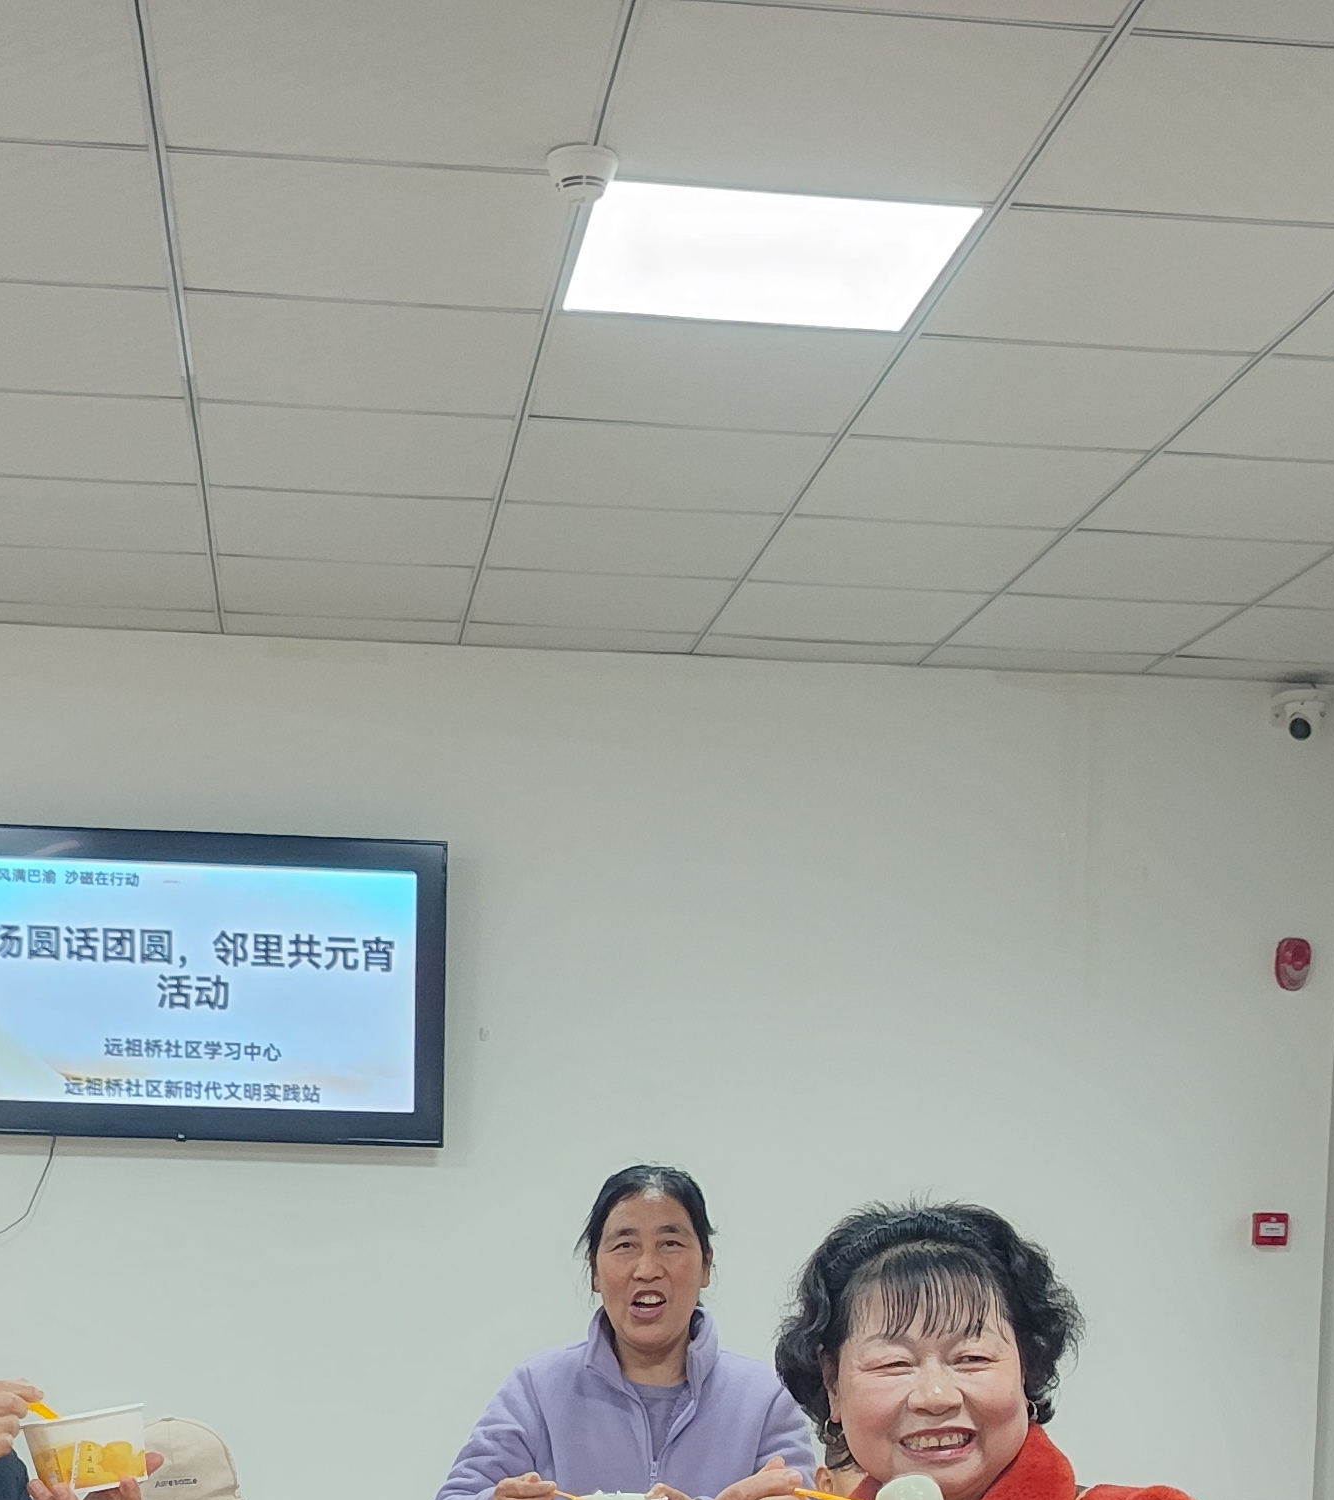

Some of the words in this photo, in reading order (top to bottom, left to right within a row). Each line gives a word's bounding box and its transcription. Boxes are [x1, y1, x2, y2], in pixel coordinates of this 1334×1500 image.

[64, 870, 140, 887] 沙磁在行动
[157, 973, 231, 1011] 活动
[103, 1036, 282, 1063] 远祖桥社区学习中心
[63, 1074, 322, 1104] 远祖桥社区新时代文明实践站
